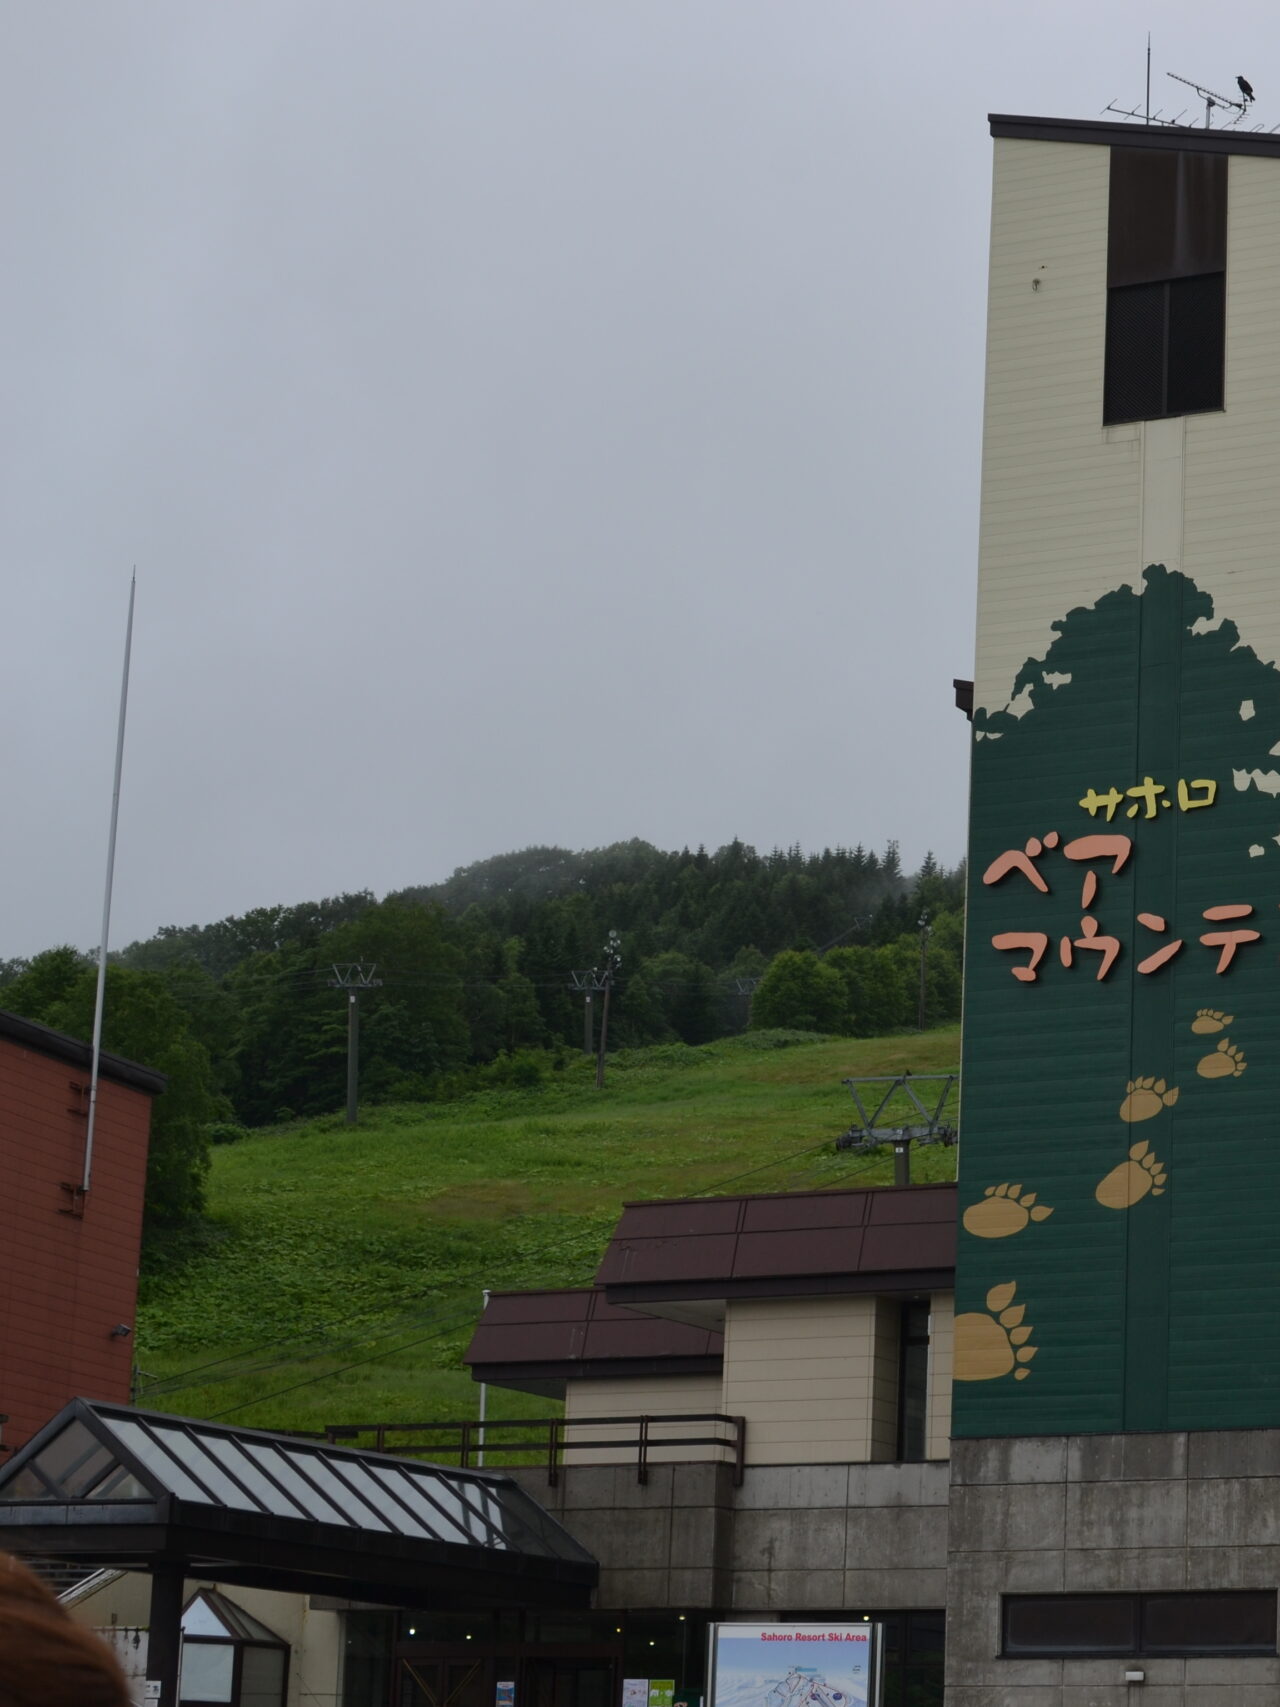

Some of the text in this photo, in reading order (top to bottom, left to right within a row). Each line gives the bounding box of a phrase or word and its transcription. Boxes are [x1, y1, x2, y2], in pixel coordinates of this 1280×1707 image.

[1079, 776, 1216, 822] サホロ
[983, 831, 1131, 909] ベア
[761, 1632, 867, 1642] Sahoro Resort Ski Area
